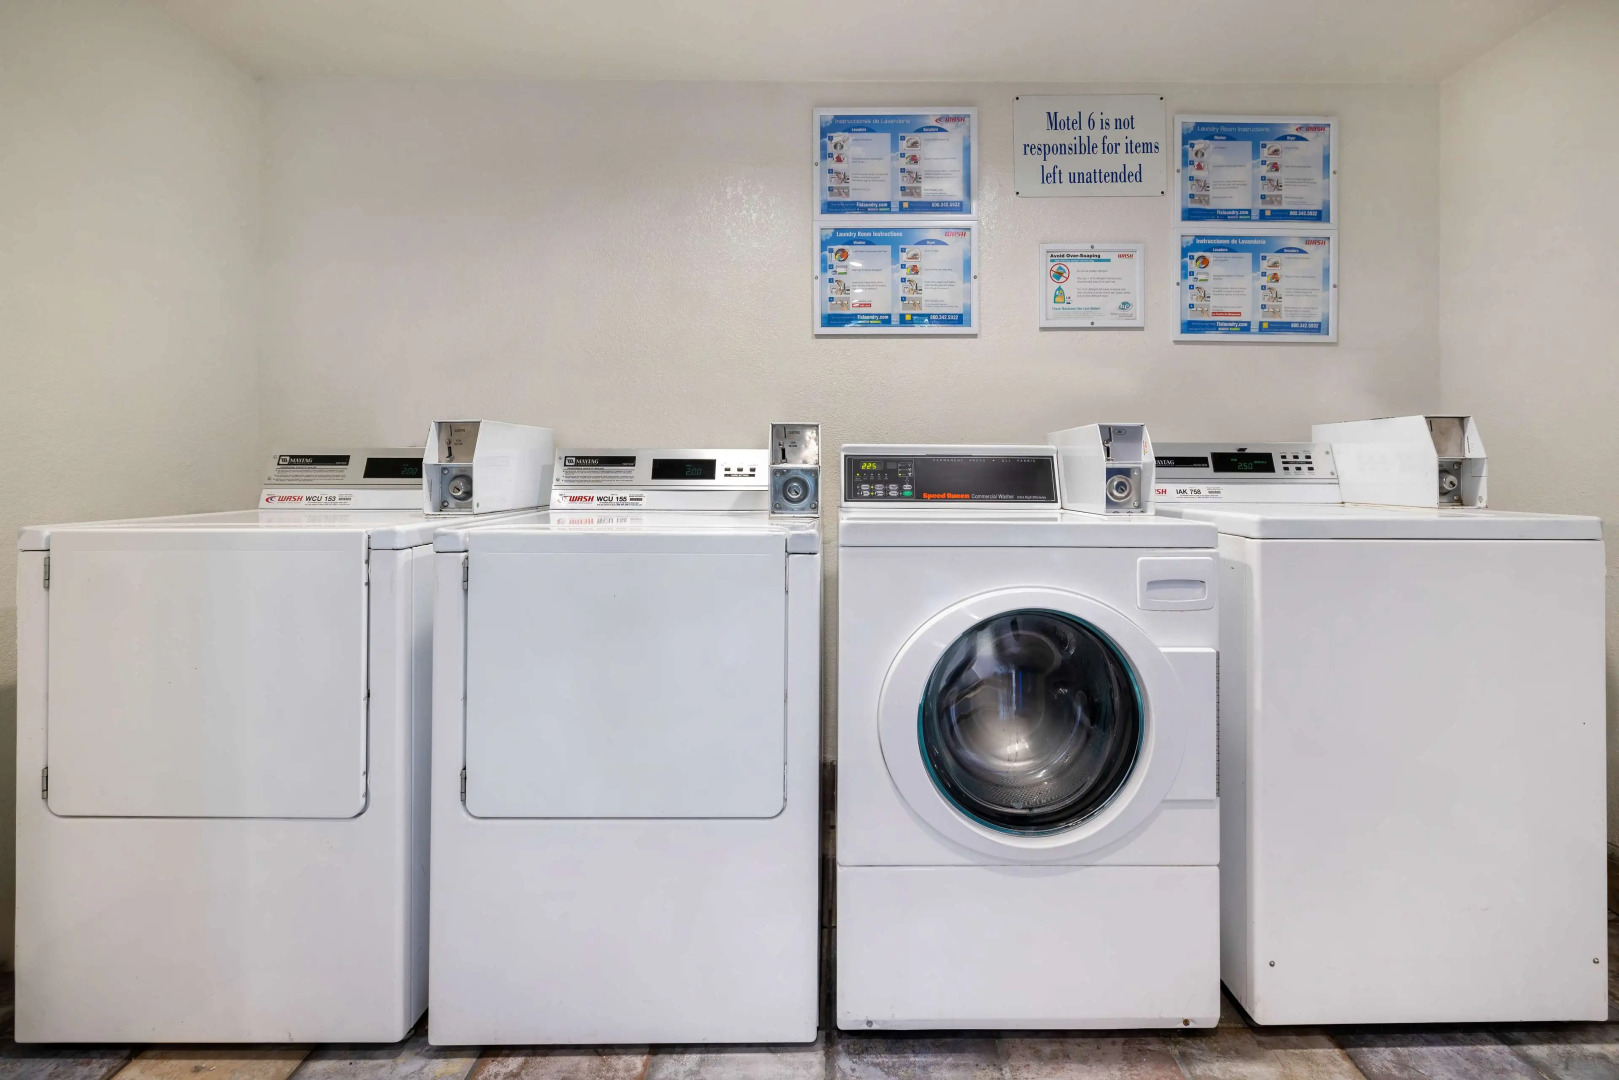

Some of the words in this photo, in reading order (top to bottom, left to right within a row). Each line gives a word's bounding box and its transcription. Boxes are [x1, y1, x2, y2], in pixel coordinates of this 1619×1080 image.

[1046, 111, 1082, 130] Motel
[1088, 112, 1095, 130] 6
[1100, 112, 1110, 130] is
[1114, 115, 1135, 130] not
[1023, 136, 1098, 161] responsible
[1101, 135, 1120, 154] for
[1125, 136, 1159, 154] items
[1041, 165, 1063, 184] left
[1068, 164, 1142, 184] unattended
[923, 492, 946, 500] Speed
